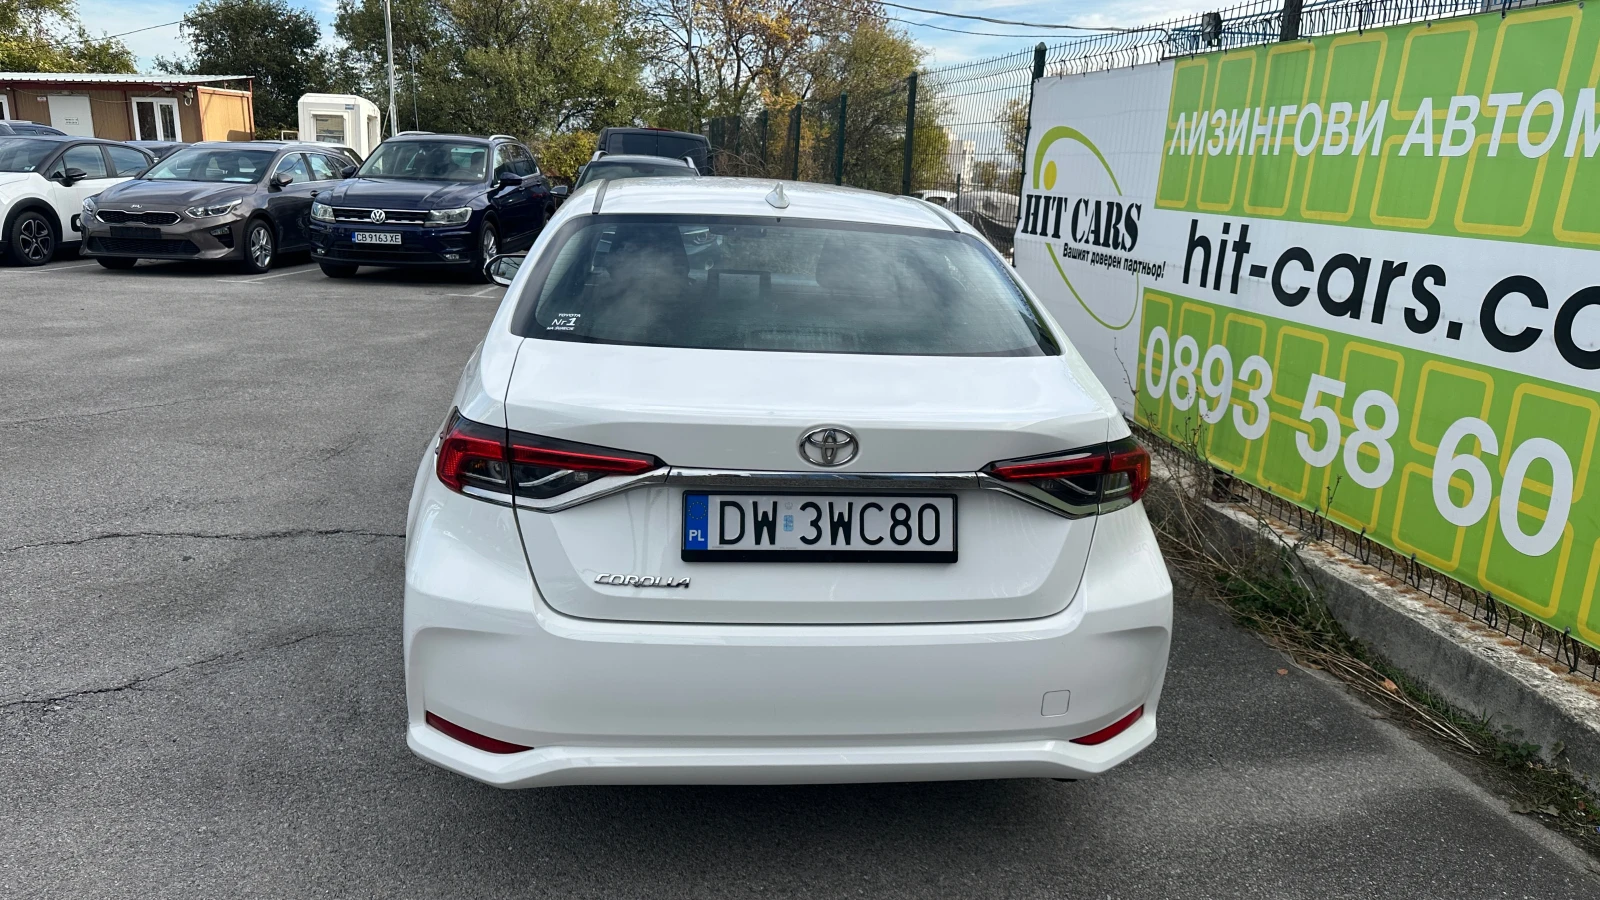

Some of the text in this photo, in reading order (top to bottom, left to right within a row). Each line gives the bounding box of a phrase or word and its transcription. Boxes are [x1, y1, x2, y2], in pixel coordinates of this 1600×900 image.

[1168, 99, 1389, 156] ЛИЗИНГОВИ
[356, 233, 400, 243] CB 9163 XE
[1021, 194, 1142, 252] HIT CARS
[1063, 243, 1166, 280] Вашият доверен партньор!
[1144, 326, 1574, 557] 0893 58 60
[688, 529, 705, 542] PL
[719, 500, 941, 546] DW 3WC80
[594, 573, 692, 589] COROLLA
